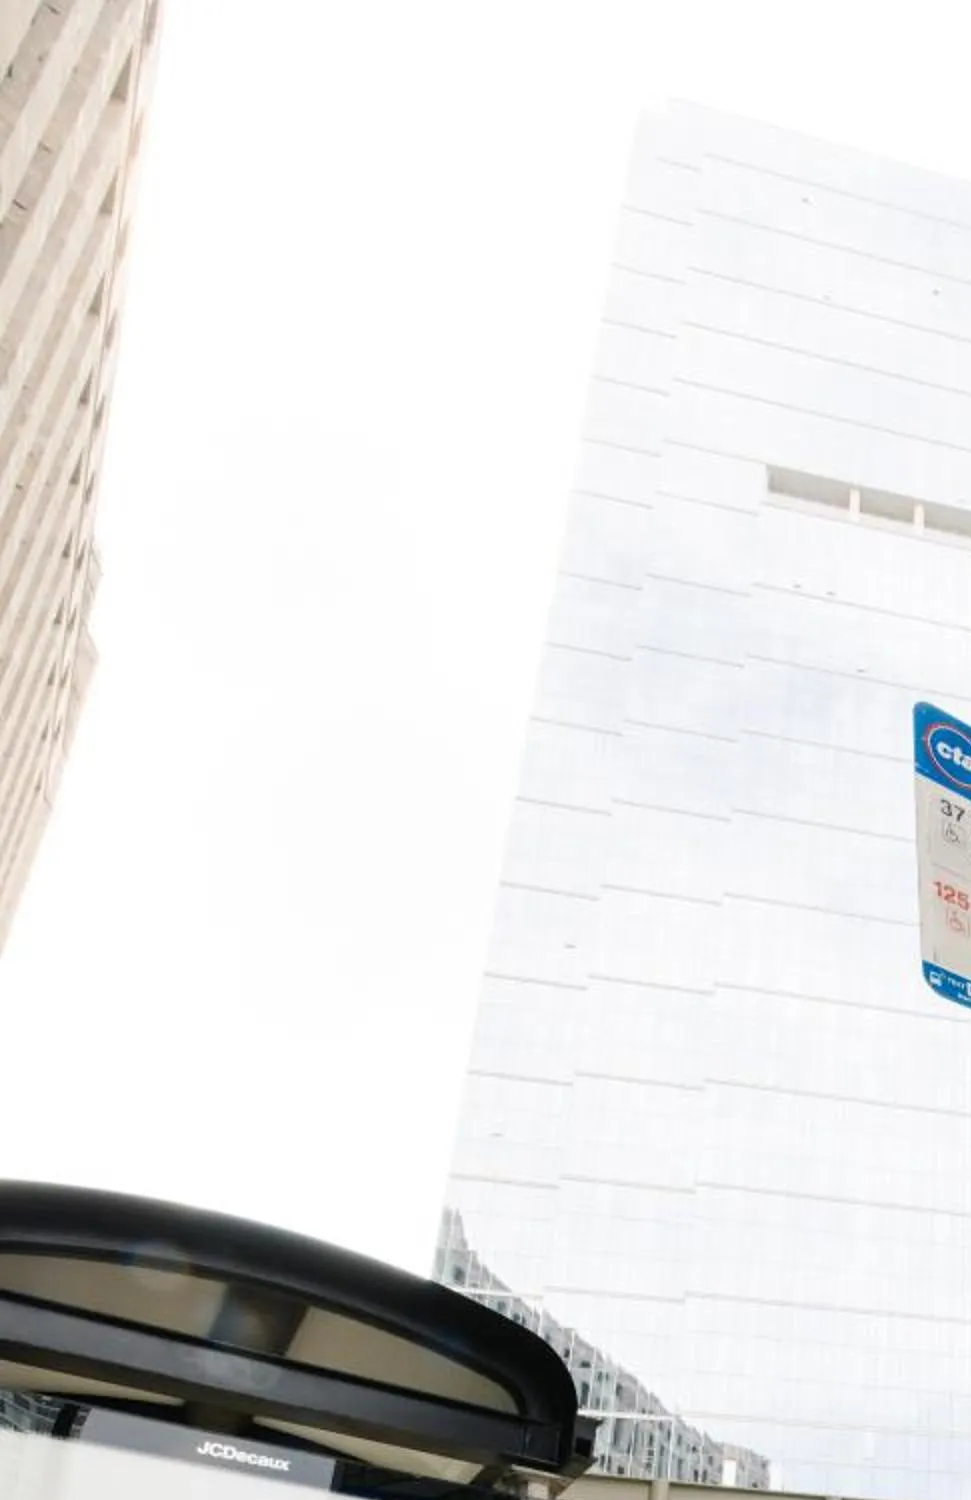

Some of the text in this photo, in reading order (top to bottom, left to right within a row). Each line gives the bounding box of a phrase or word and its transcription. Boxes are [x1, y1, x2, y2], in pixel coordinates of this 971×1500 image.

[940, 799, 966, 823] 37
[932, 881, 970, 912] 125
[197, 1441, 290, 1471] JCDecaux
